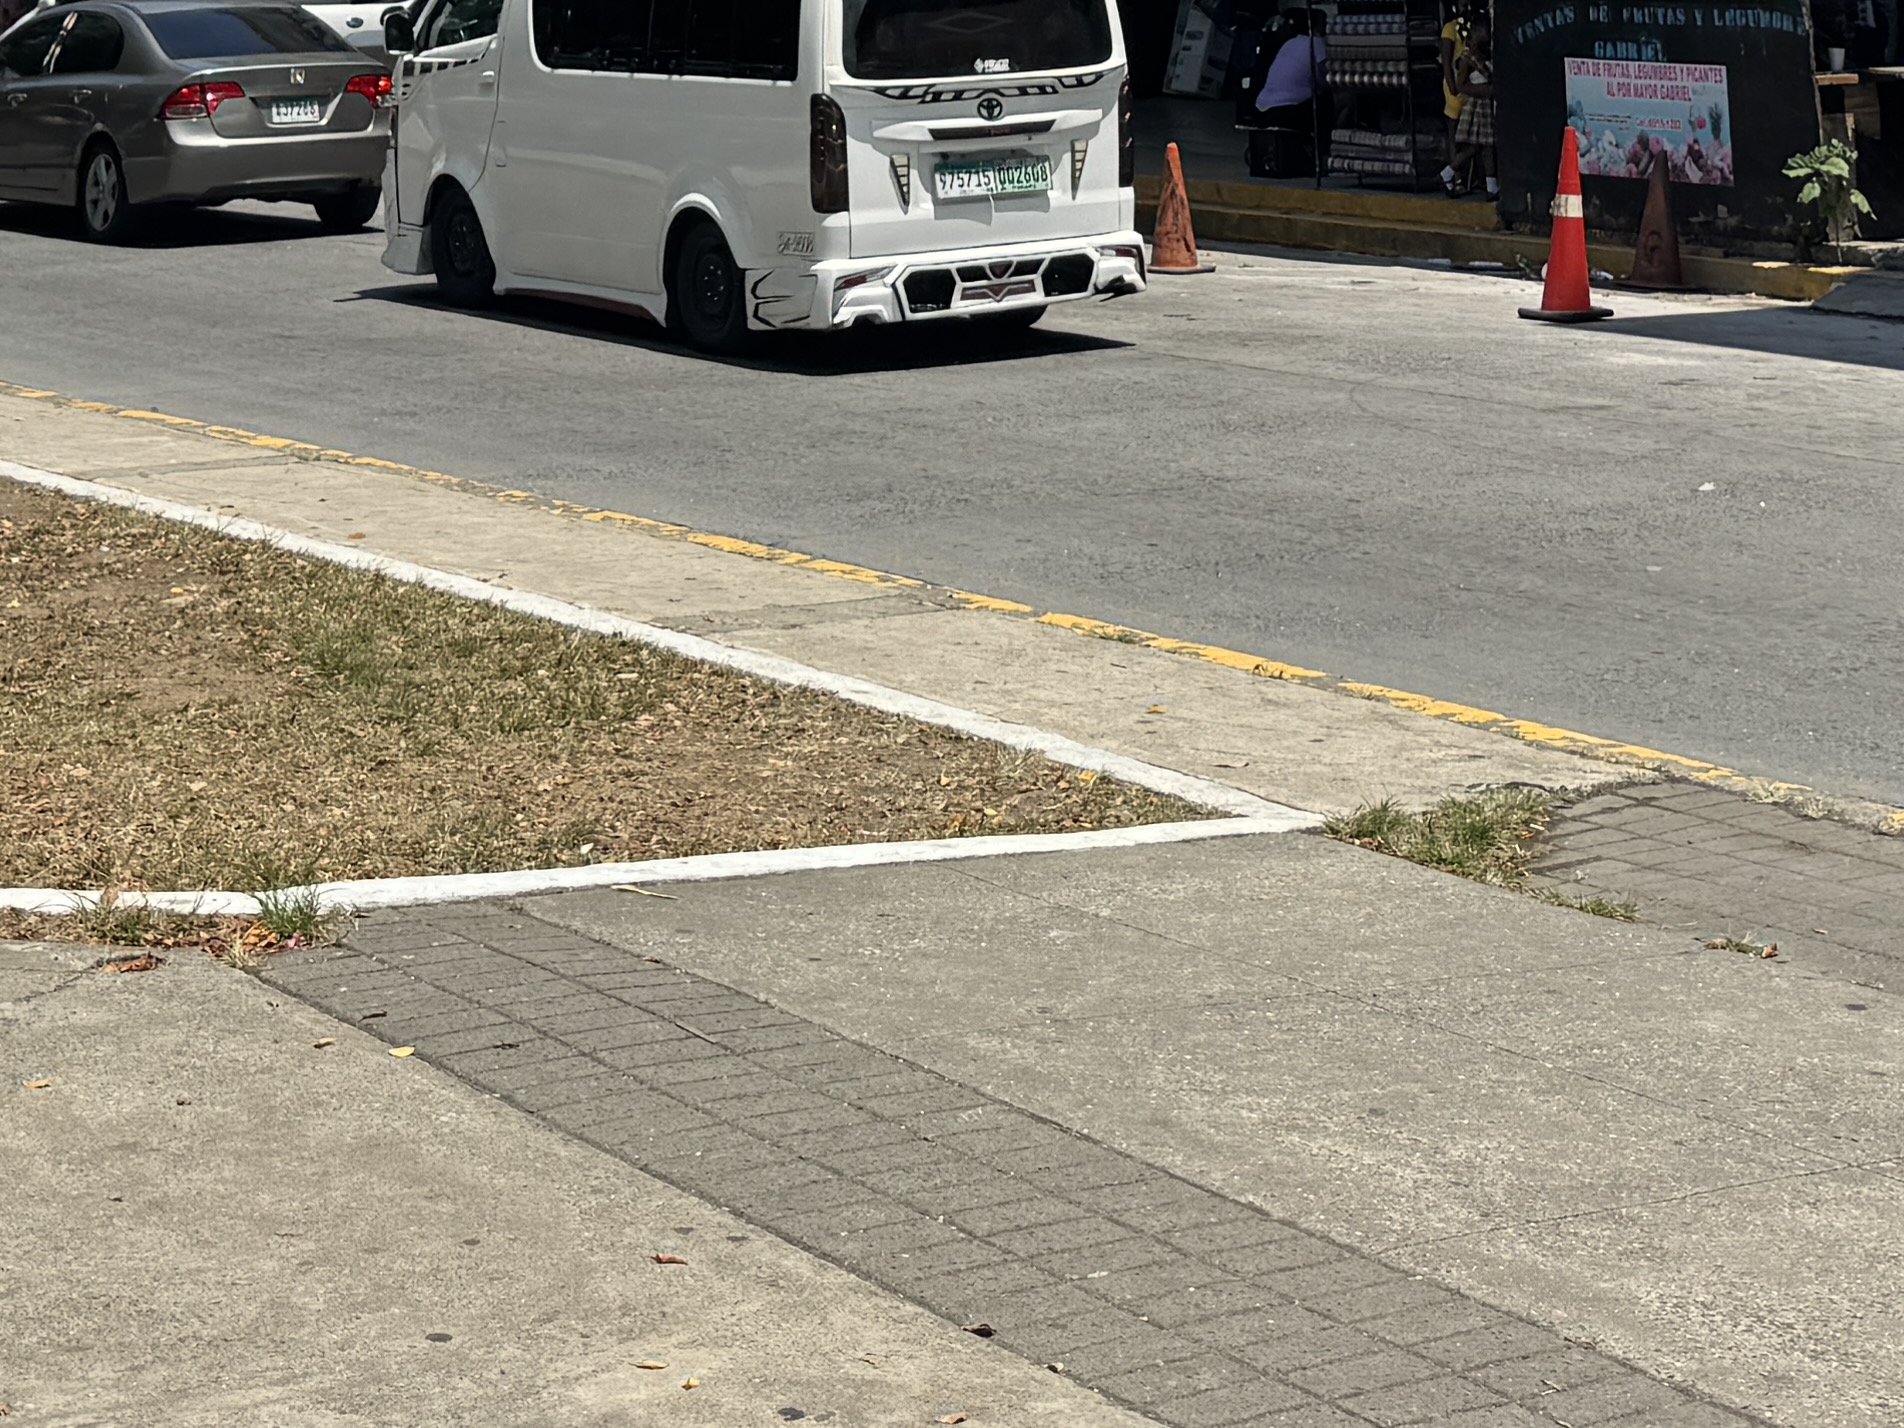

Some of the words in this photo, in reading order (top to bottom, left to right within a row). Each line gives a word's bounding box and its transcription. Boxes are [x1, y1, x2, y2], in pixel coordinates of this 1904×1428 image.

[1513, 5, 1576, 45] VENTAS
[1588, 4, 1609, 24] DE
[1622, 5, 1687, 27] FRUTAS
[1694, 8, 1705, 27] Y
[1593, 36, 1667, 61] GABRIEL
[1569, 60, 1592, 77] VENTA
[1592, 61, 1602, 77] DE
[1633, 63, 1678, 82] LEGUMBRES
[1679, 66, 1685, 82] Y
[1686, 66, 1723, 84] PICANTES
[1606, 81, 1616, 97] AL
[1616, 82, 1633, 98] POR
[1633, 83, 1659, 99] MAYOR
[1660, 85, 1693, 102] GABRIEL
[939, 169, 991, 191] 975715
